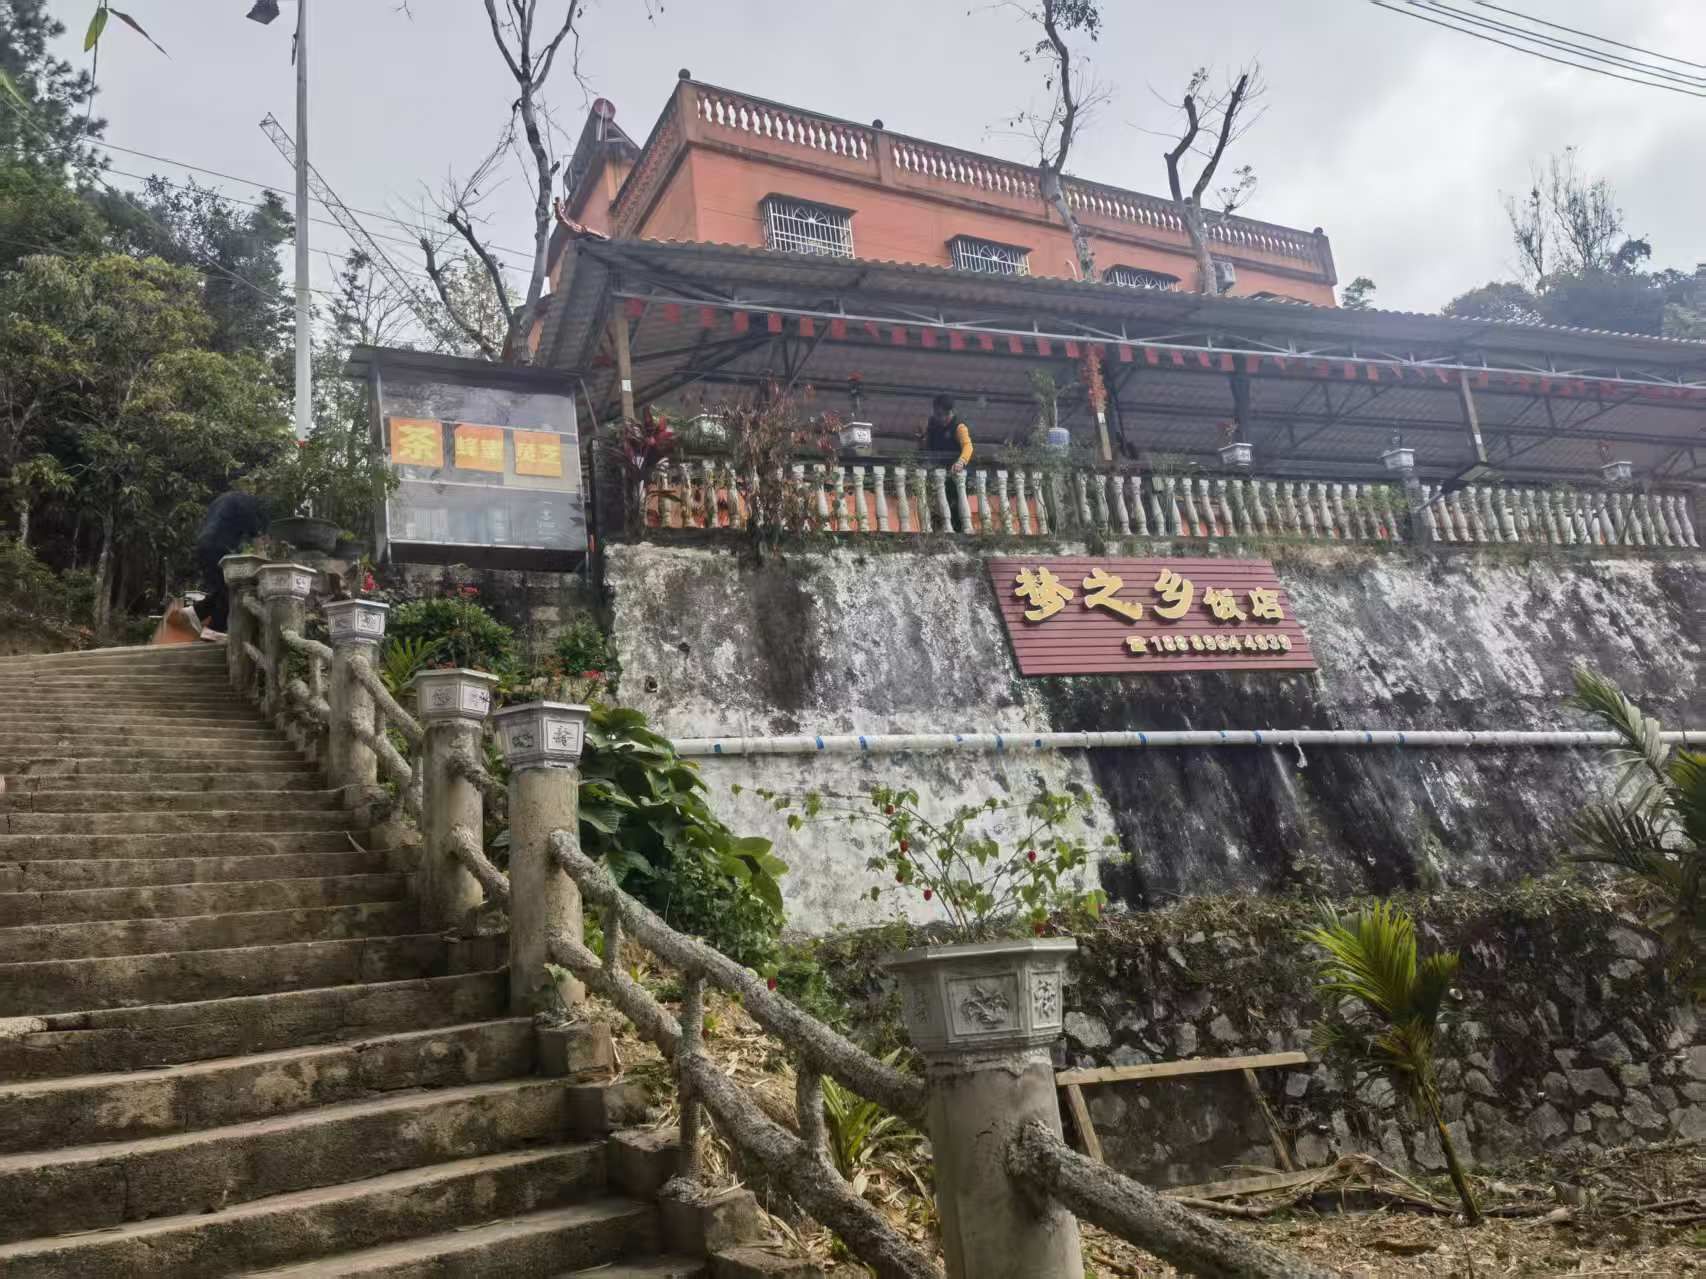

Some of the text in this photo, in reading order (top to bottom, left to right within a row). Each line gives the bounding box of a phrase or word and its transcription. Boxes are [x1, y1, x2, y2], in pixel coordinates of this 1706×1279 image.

[398, 424, 436, 461] 茶
[1014, 566, 1285, 621] 梦之乡饭店
